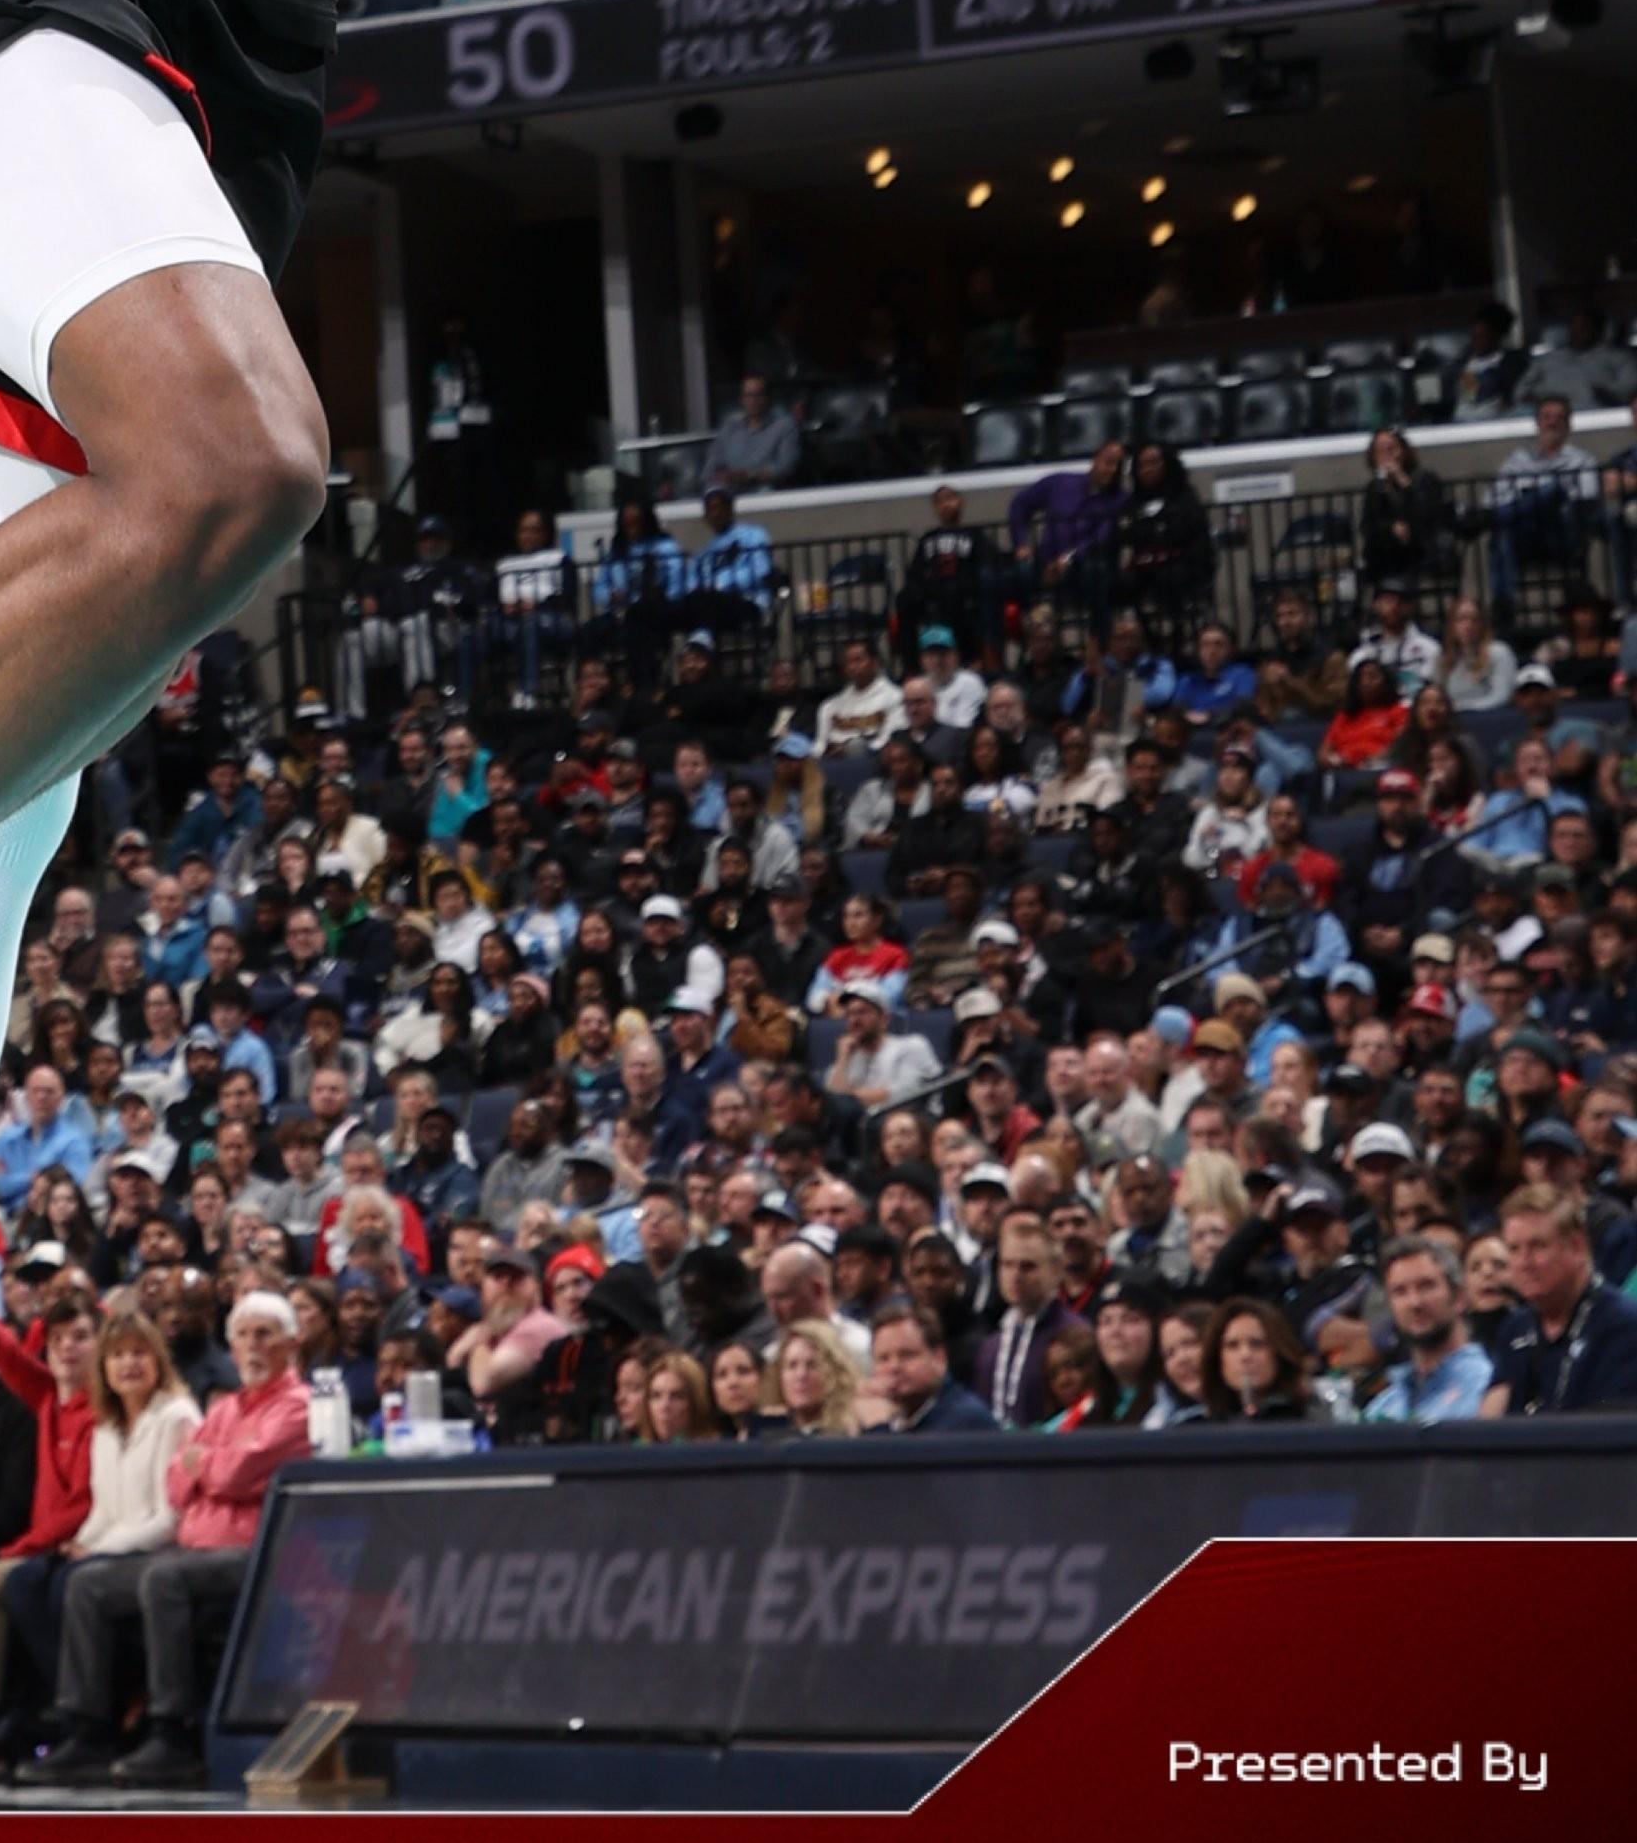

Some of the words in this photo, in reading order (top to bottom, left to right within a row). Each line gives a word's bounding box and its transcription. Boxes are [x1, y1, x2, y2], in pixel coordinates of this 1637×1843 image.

[446, 9, 574, 110] 50
[372, 1549, 734, 1643] AMERICAN
[744, 1543, 1108, 1645] EXPRESS
